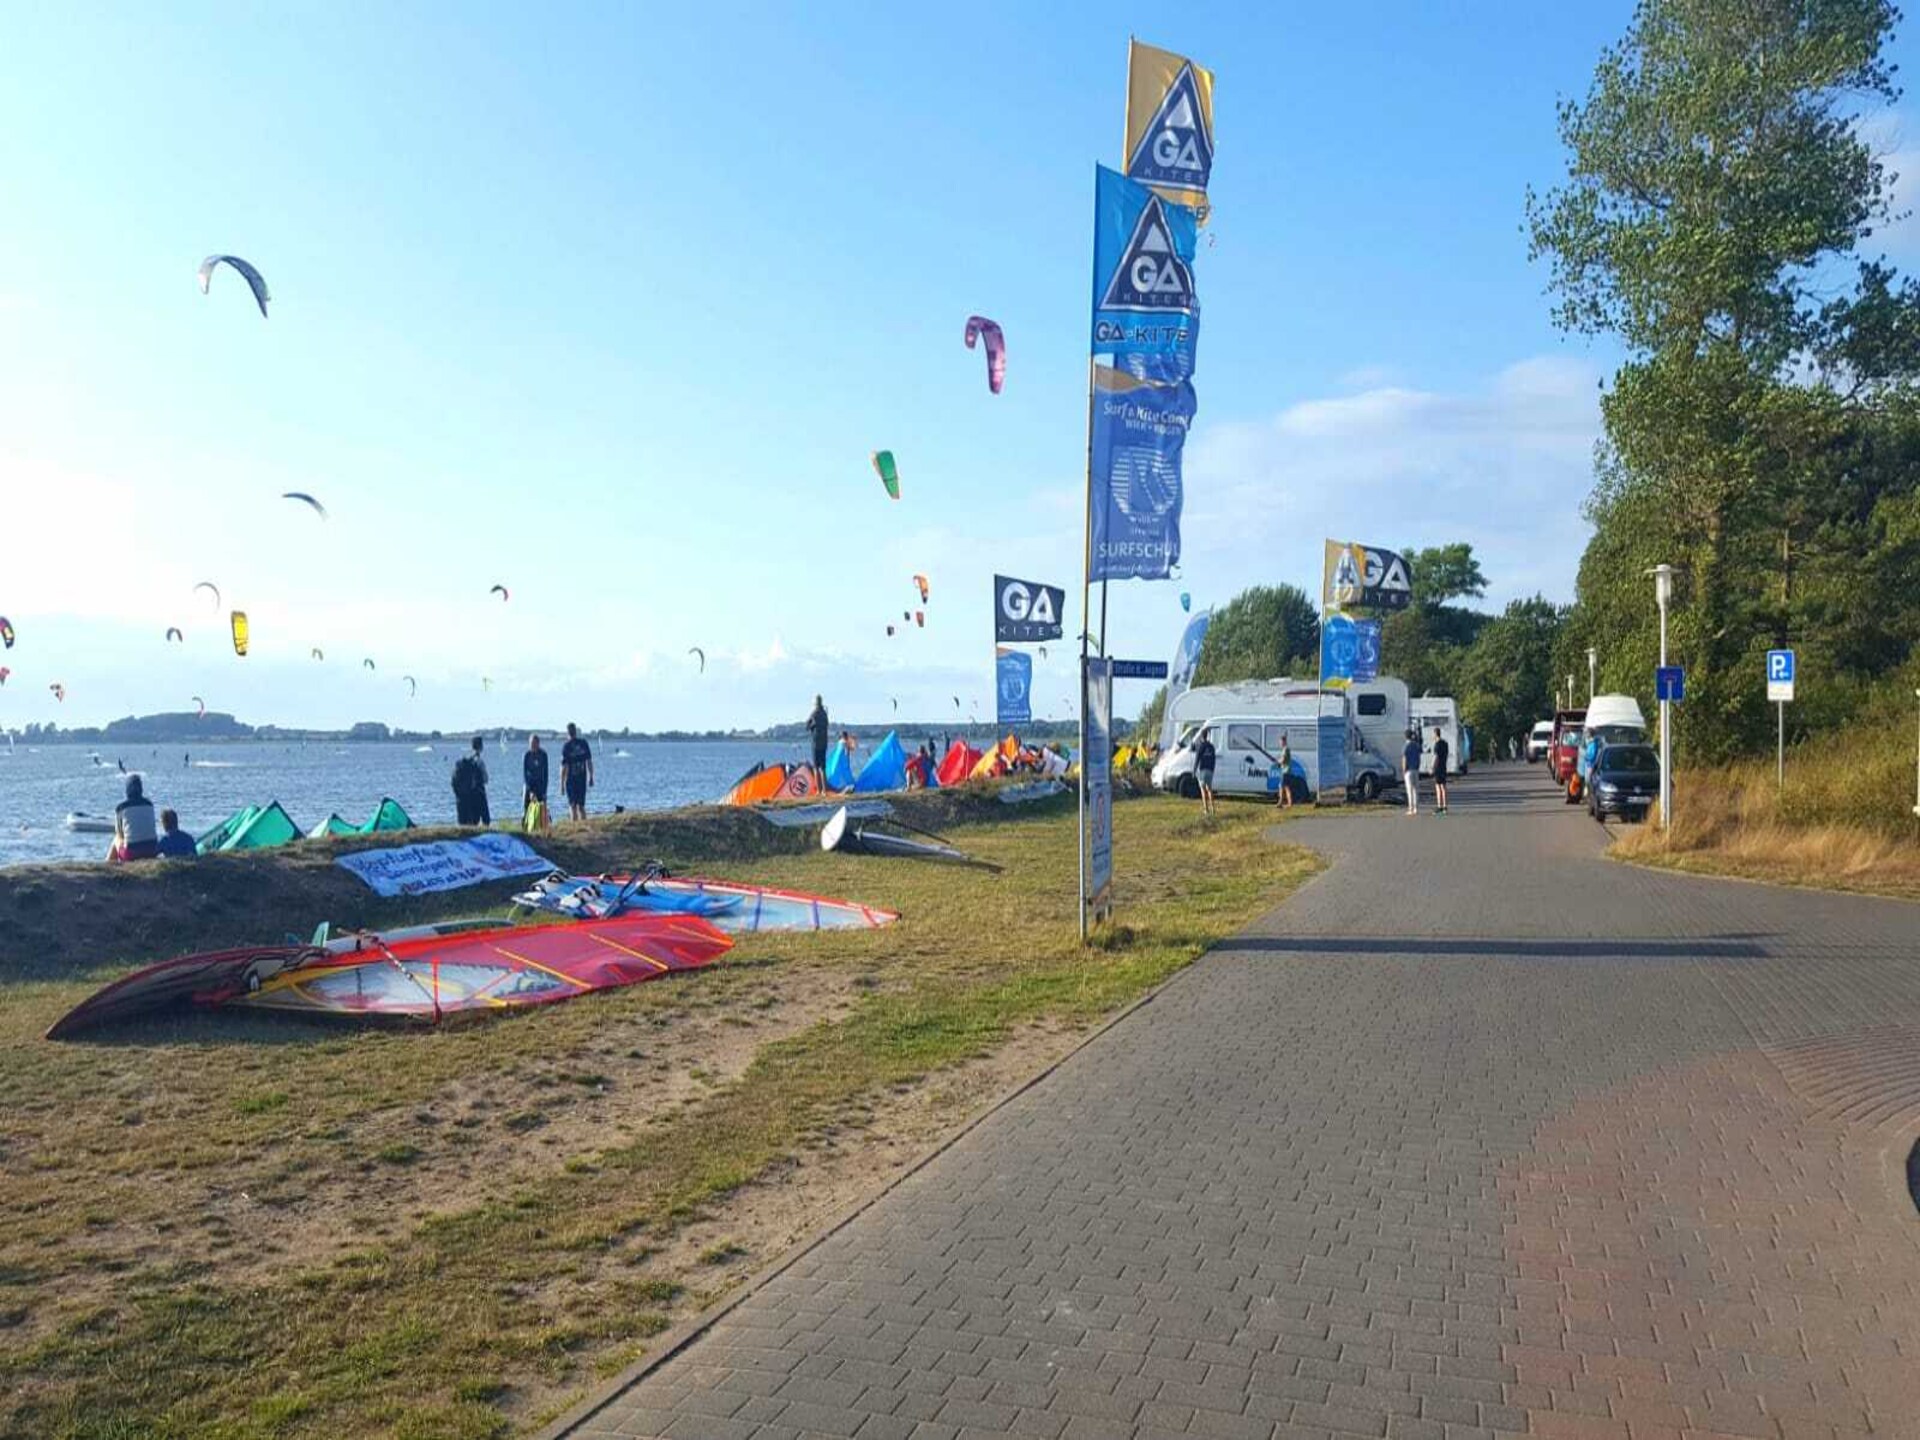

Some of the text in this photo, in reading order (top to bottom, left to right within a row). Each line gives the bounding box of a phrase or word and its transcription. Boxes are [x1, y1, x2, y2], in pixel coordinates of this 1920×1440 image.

[1153, 129, 1203, 171] GA
[1131, 255, 1184, 294] GA
[1099, 541, 1178, 558] SURFSCHUL
[1361, 549, 1411, 591] GA
[1002, 581, 1057, 624] GA
[1772, 655, 1786, 679] P
